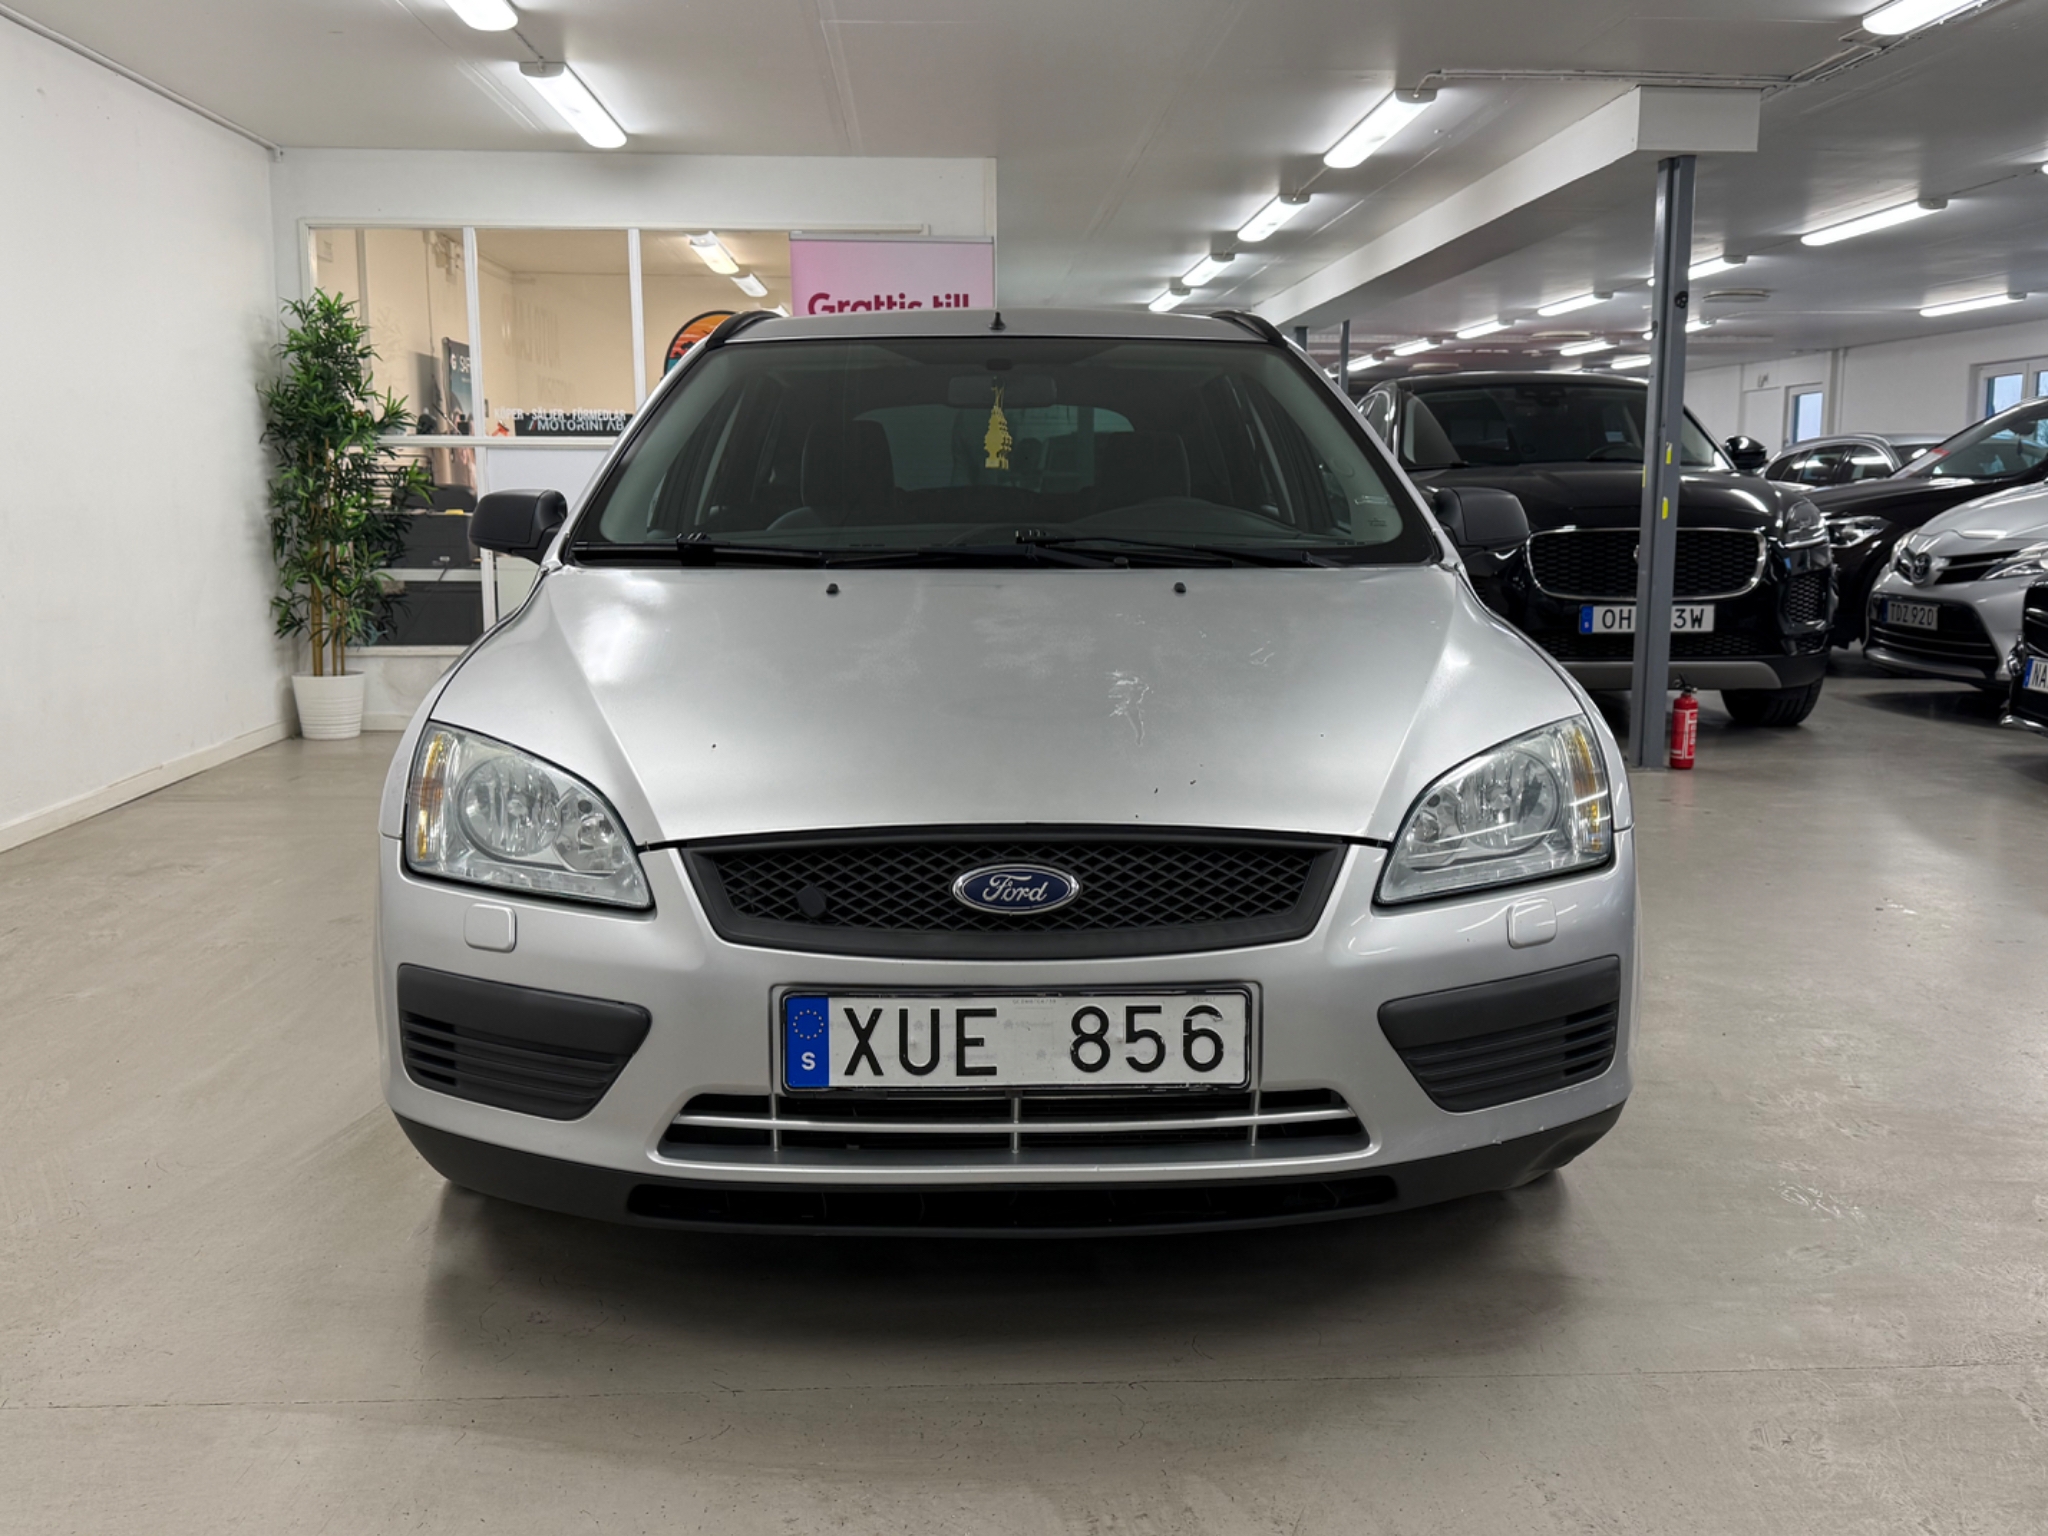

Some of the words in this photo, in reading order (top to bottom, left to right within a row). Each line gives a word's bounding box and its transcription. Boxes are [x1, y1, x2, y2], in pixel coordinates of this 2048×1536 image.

[531, 406, 564, 420] SÄLJER
[572, 406, 626, 420] FÖRMEDLAR
[982, 874, 1049, 902] Ford
[843, 1007, 998, 1077] XUE
[1070, 1004, 1225, 1073] 856
[801, 1052, 816, 1071] S
